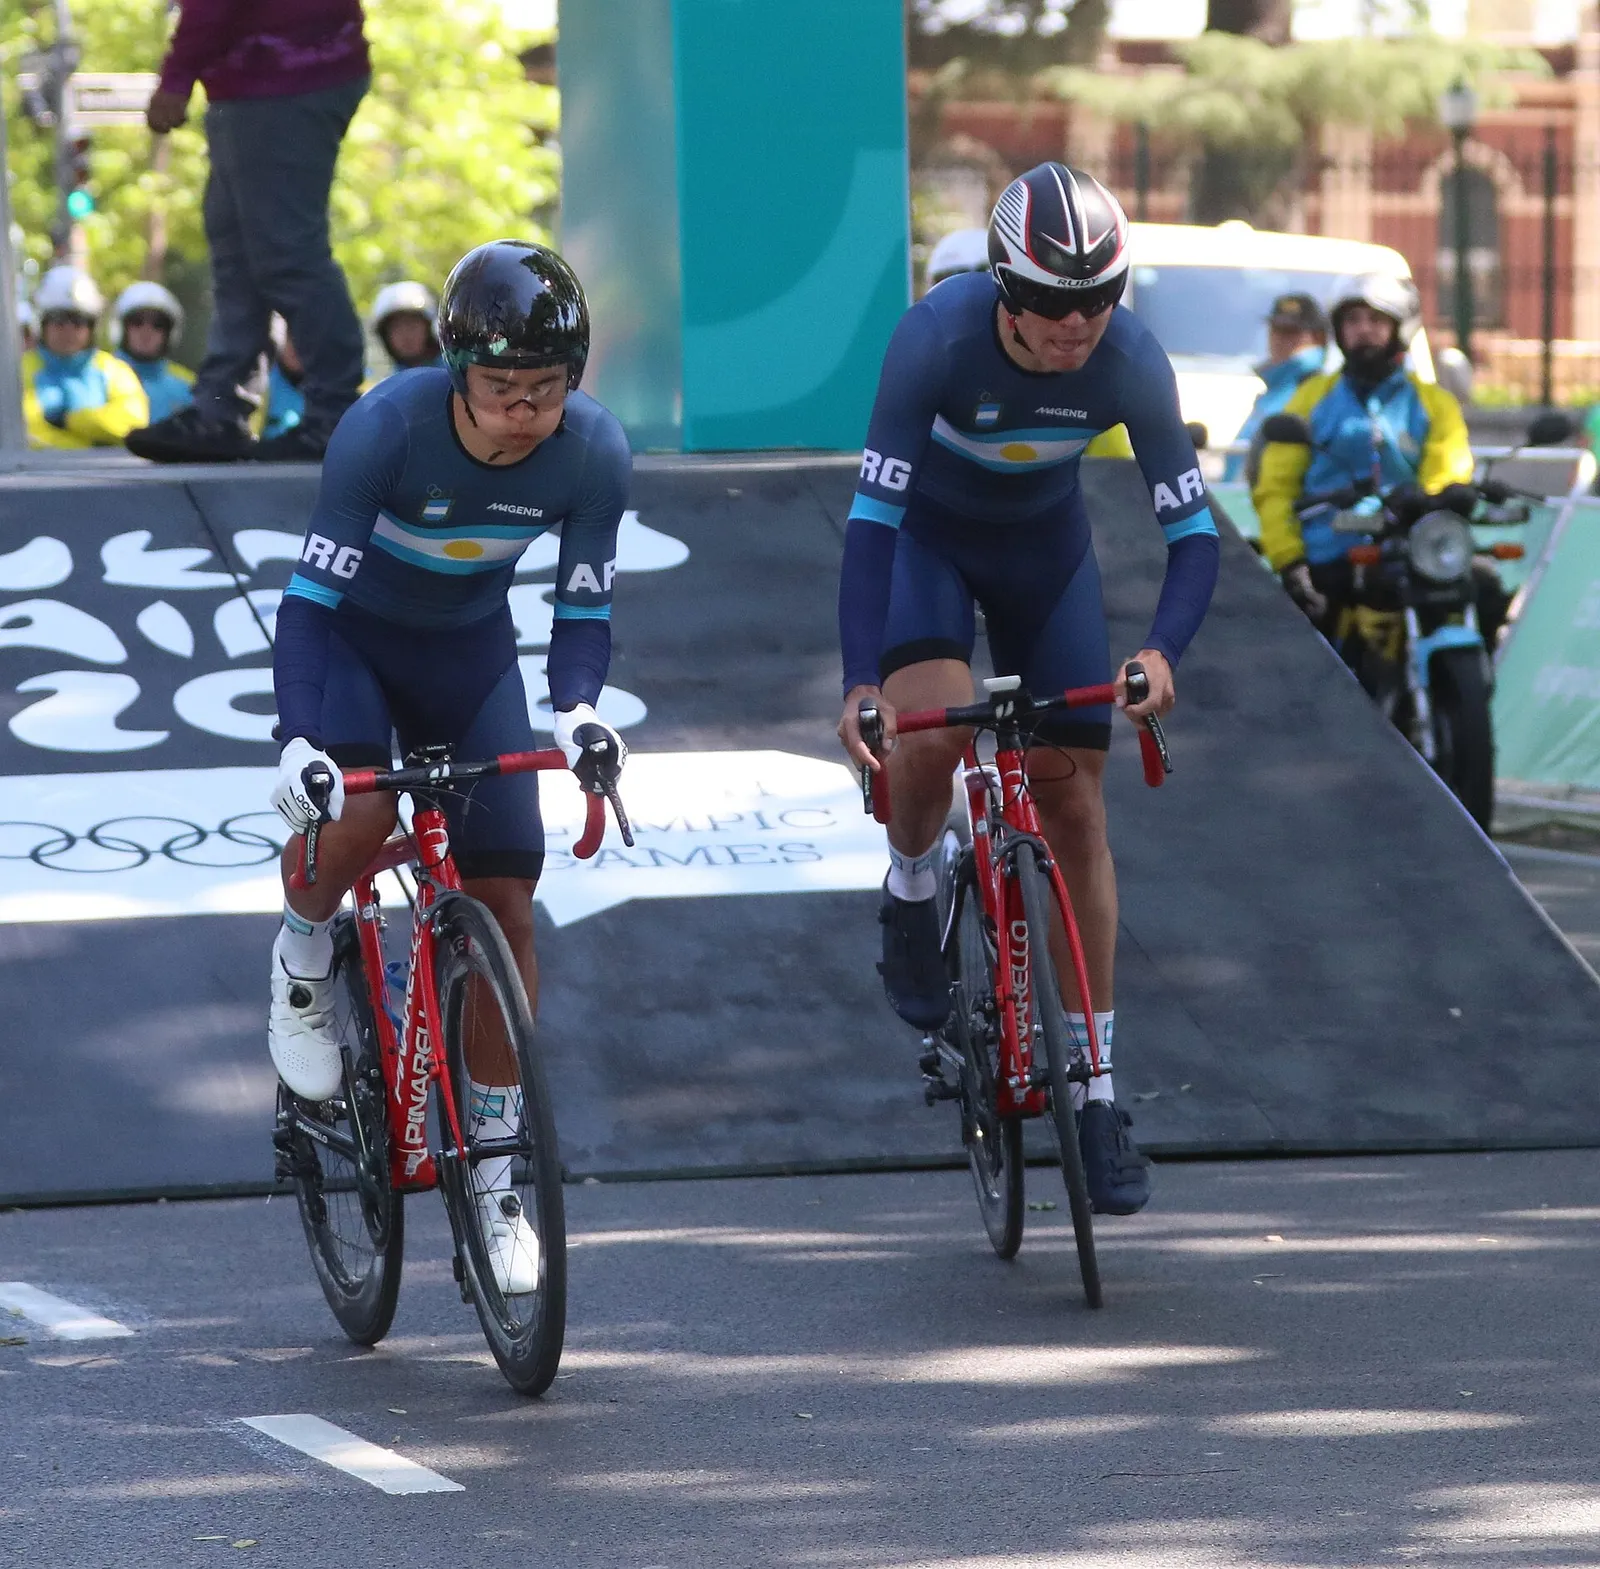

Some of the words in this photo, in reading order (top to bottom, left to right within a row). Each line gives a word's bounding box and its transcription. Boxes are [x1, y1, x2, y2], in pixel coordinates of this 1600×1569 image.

[1057, 277, 1099, 287] RUDY
[1034, 406, 1088, 420] MAGENTA
[860, 447, 912, 491] RG
[1154, 467, 1204, 513] AR
[486, 502, 544, 518] MAGENTA
[302, 532, 364, 579] RG
